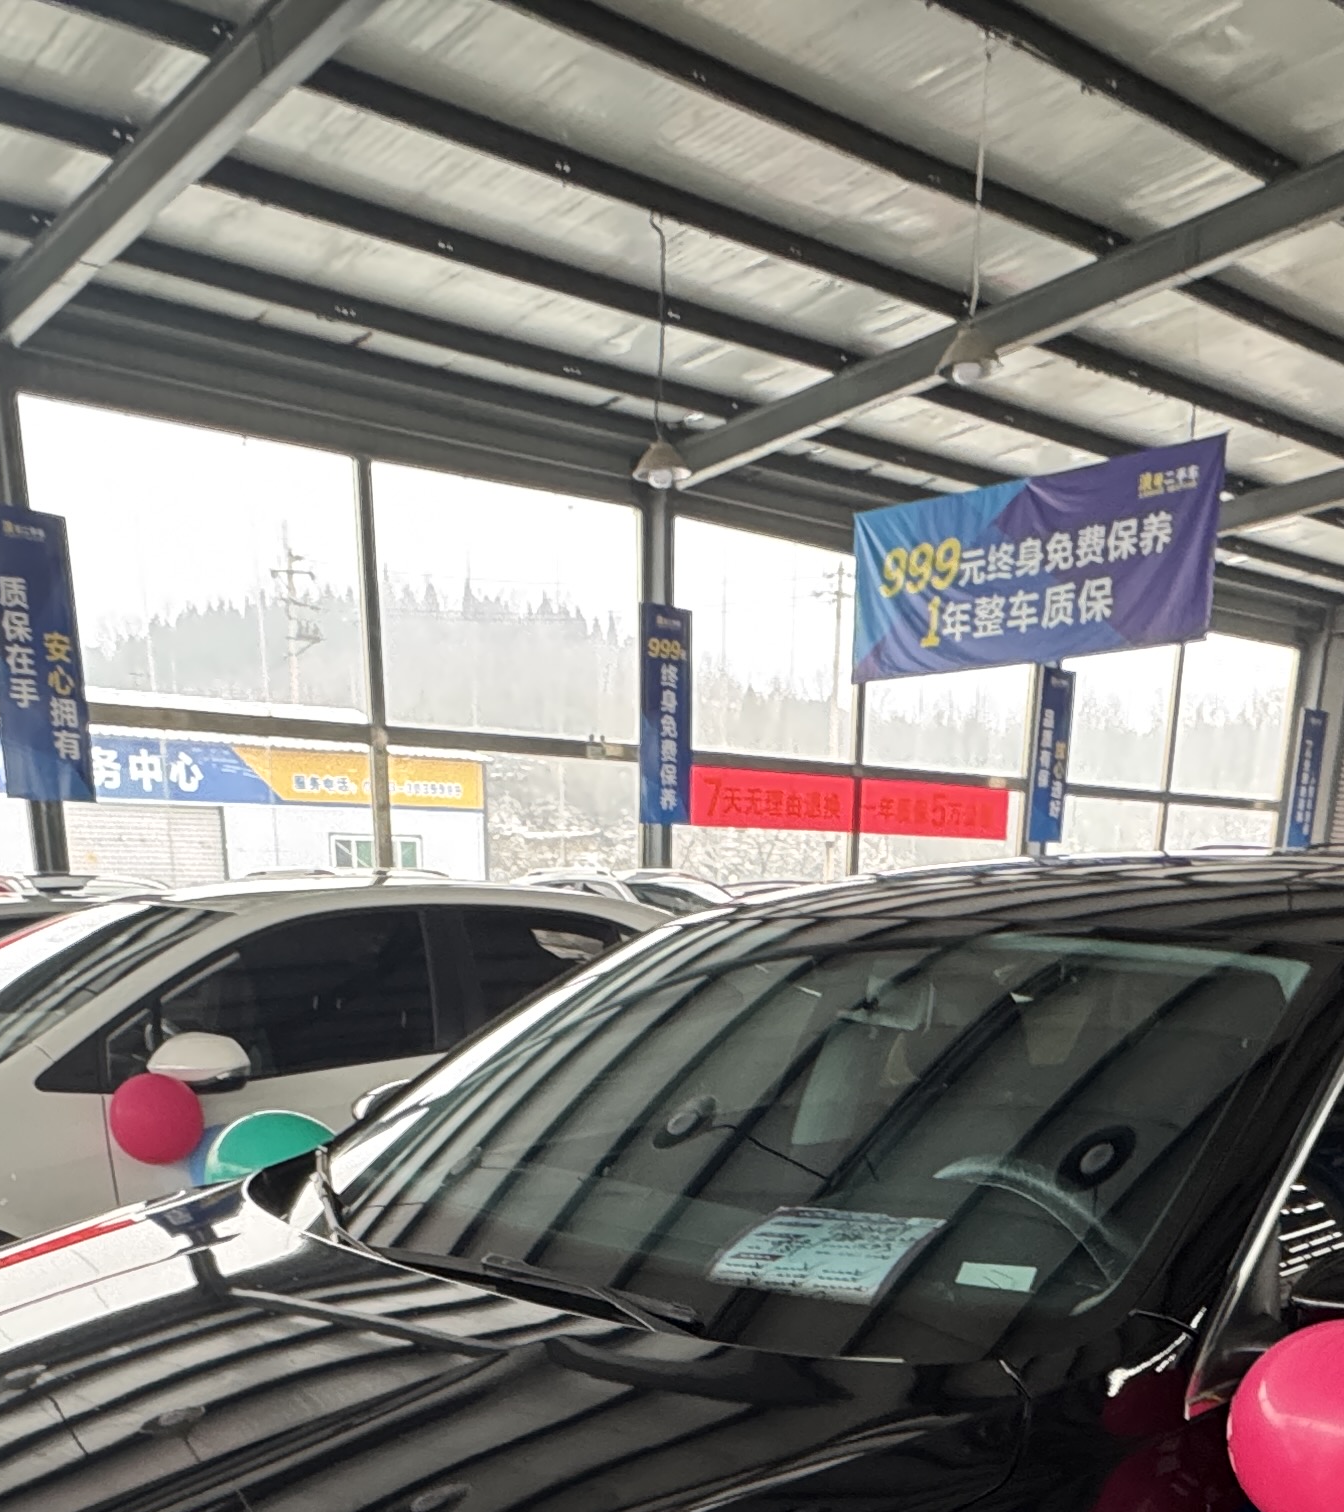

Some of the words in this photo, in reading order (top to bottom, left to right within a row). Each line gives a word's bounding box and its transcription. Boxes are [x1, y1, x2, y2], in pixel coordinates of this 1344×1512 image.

[879, 510, 1173, 598] 999元终身免费保养
[920, 577, 1114, 648] 1年整车质保
[42, 631, 81, 761] 安心拥有
[91, 744, 205, 792] 务中心
